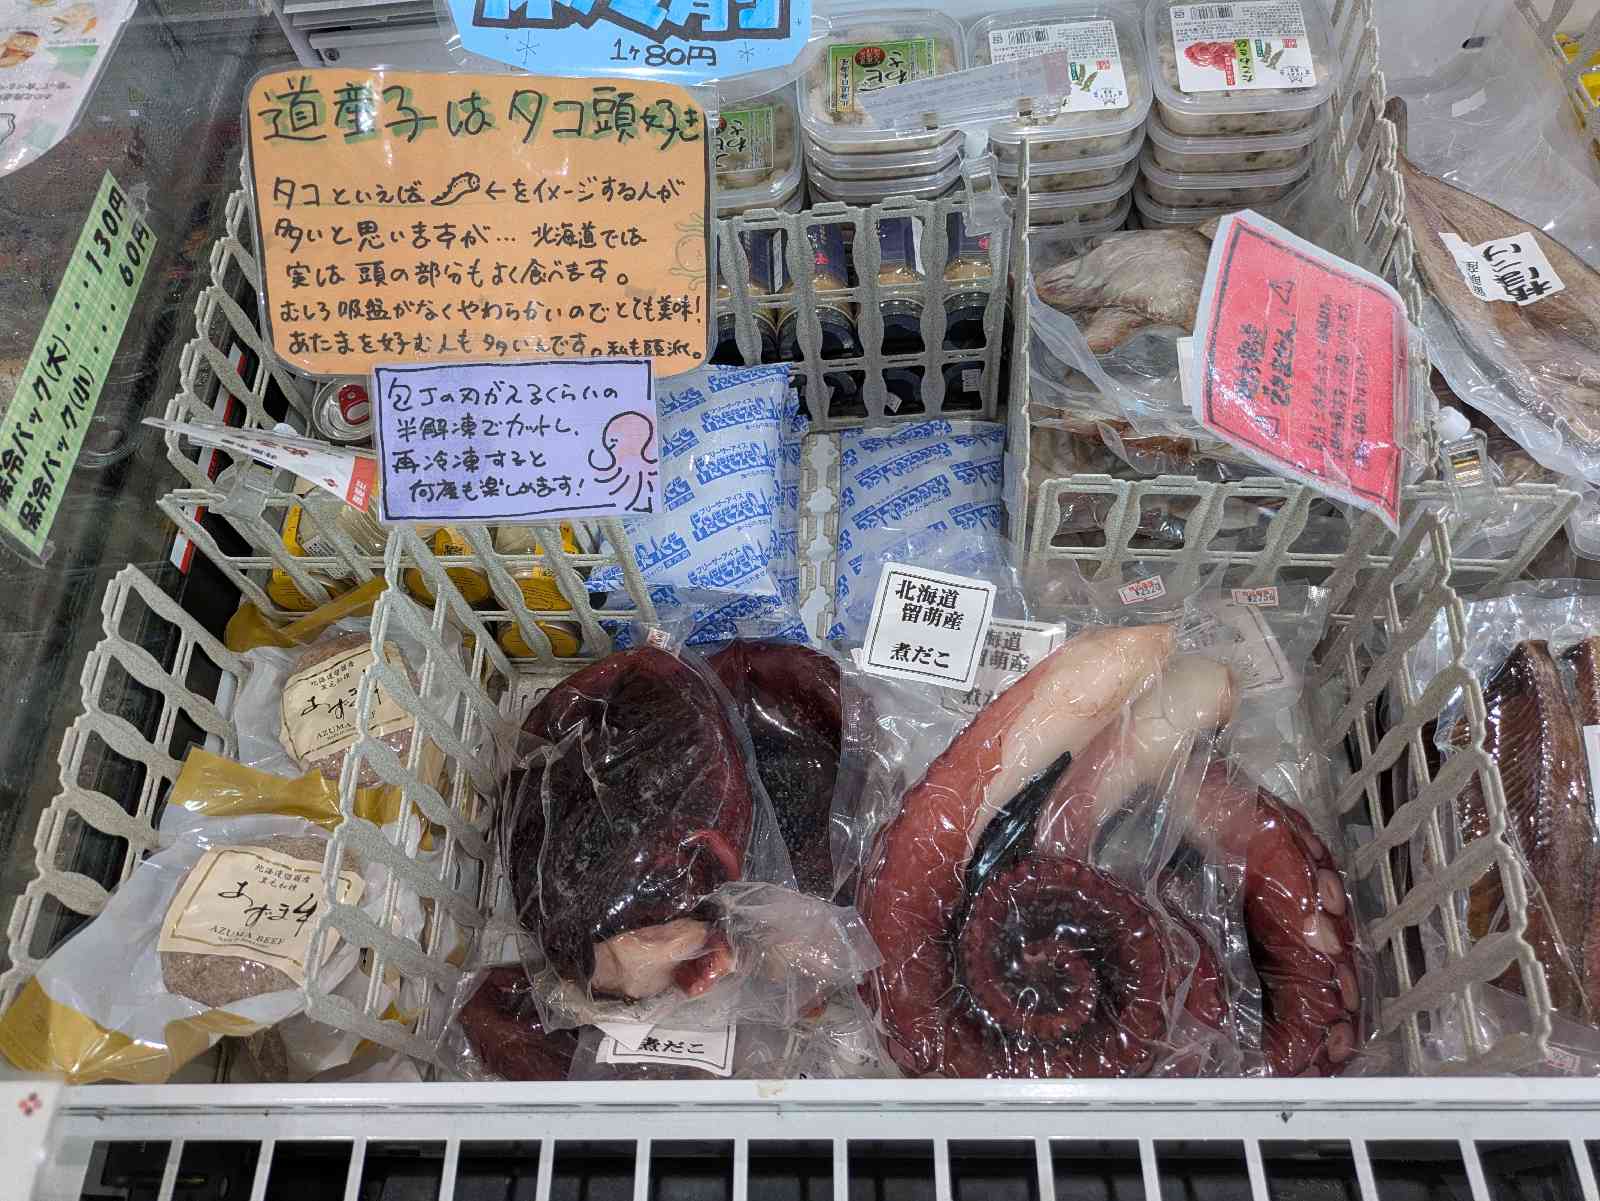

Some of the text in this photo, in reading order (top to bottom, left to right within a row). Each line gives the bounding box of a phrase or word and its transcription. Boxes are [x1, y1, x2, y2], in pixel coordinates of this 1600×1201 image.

[273, 175, 687, 210] タコといえば をイメージする人が
[391, 446, 548, 474] 再冷凍すると
[408, 474, 584, 502] 何度も楽しめます!
[895, 579, 960, 610] 北海道
[902, 602, 965, 631] 留萌産
[890, 642, 950, 669] 煮だこ
[209, 925, 253, 942] AZUMA
[640, 1036, 705, 1054] 煮だこ
